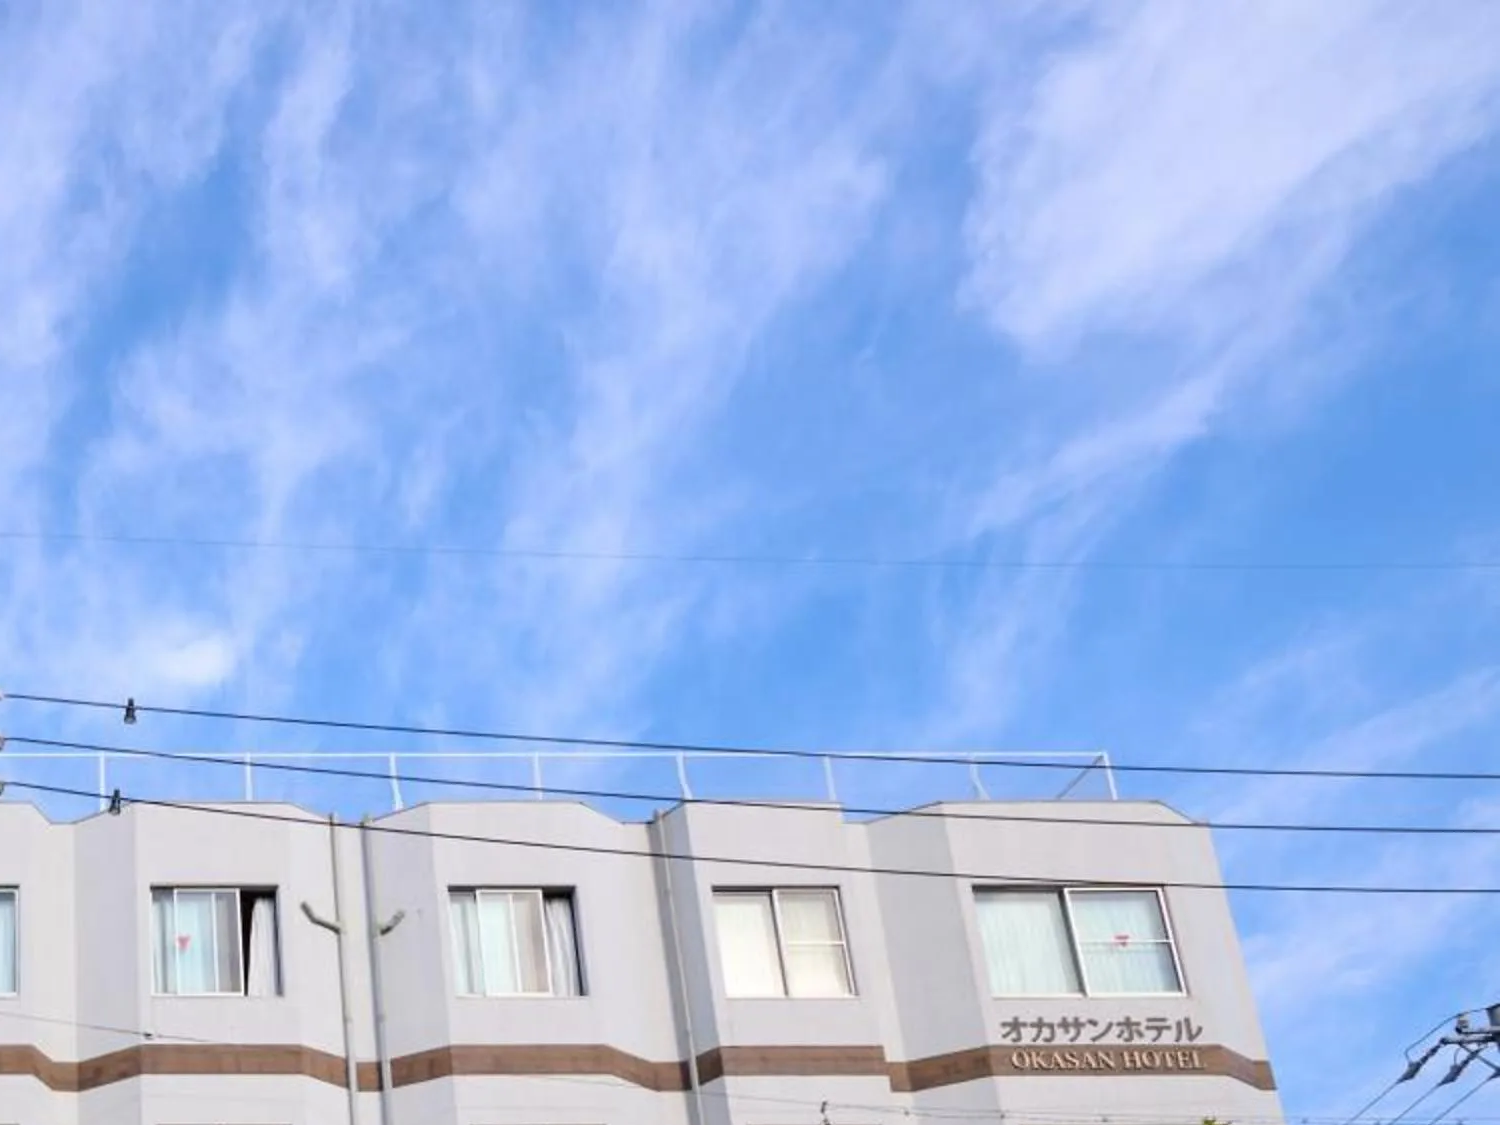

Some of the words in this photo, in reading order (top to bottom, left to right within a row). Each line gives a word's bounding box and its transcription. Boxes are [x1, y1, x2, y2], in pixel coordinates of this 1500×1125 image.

[1000, 1016, 1203, 1042] オカサンホテル
[1011, 1049, 1114, 1070] OKASAN
[1123, 1049, 1206, 1070] HOTEL
